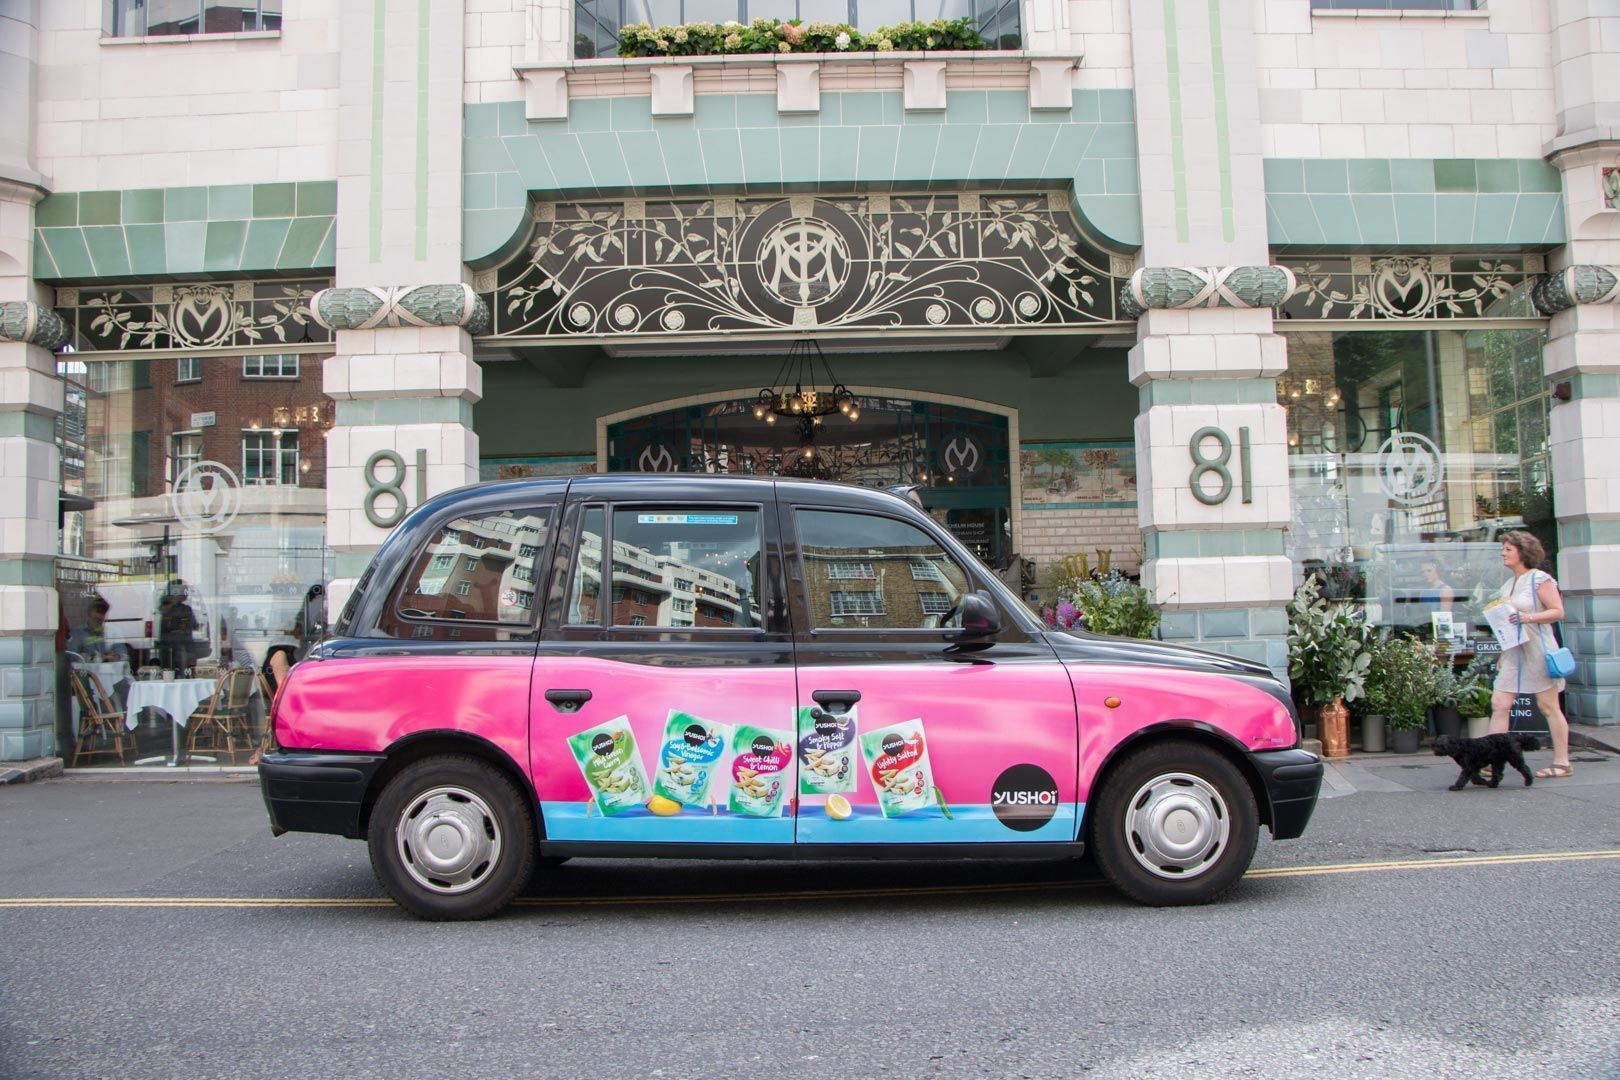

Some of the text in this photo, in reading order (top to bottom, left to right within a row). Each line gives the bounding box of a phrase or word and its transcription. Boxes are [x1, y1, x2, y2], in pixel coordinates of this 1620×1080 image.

[1189, 426, 1252, 505] 81
[364, 448, 427, 528] 81
[1477, 643, 1501, 651] GRAC
[1512, 697, 1531, 706] NTS
[1509, 709, 1532, 717] LING
[808, 732, 845, 745] Smoky Salt
[823, 741, 843, 750] Pepper
[743, 755, 780, 764] Sweet Chilli
[876, 749, 918, 770] Lightly Salted
[757, 763, 778, 771] Lemon
